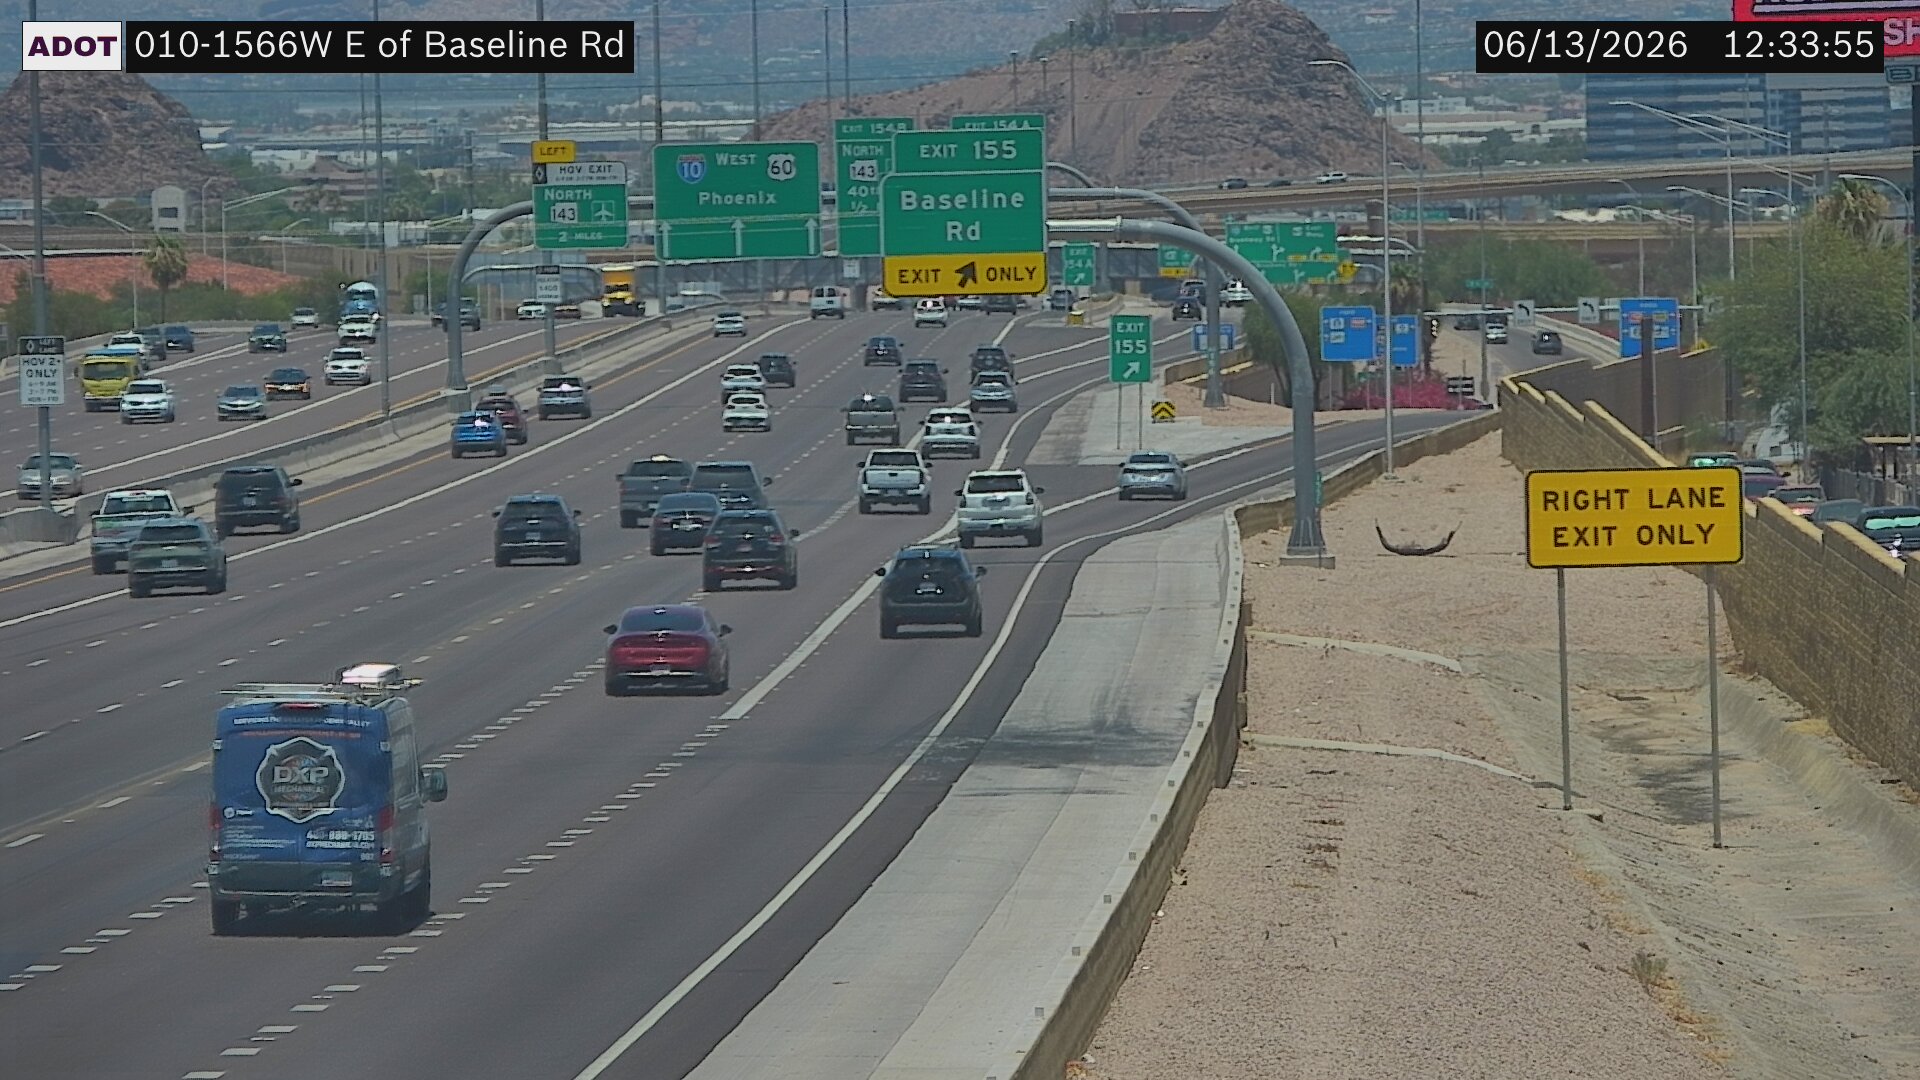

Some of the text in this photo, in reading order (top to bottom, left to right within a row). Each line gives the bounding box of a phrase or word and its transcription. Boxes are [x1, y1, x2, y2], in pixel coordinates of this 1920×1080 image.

[842, 124, 864, 134] EXIT
[540, 146, 567, 156] LEFT
[842, 145, 885, 157] NORTH
[919, 139, 1017, 160] EXIT 155
[559, 165, 613, 175] HOV EXIT
[681, 153, 793, 179] 10 WEST 60
[850, 165, 876, 179] 143
[544, 188, 593, 201] NORTH
[698, 191, 777, 206] Phoenix
[900, 188, 1025, 211] Baseline
[551, 207, 576, 221] 143
[558, 231, 603, 243] 2 MILES
[946, 220, 981, 242] Rd
[1069, 248, 1088, 256] EXIT
[898, 266, 1037, 284] EXIT ONLY
[1116, 322, 1145, 333] EXIT
[1114, 339, 1147, 355] 155
[22, 357, 46, 366] HOV
[25, 369, 57, 378] ONLY
[1542, 486, 1726, 512] RIGHT LANE
[1553, 523, 1715, 548] EXIT ONLY
[273, 765, 329, 784] DXP
